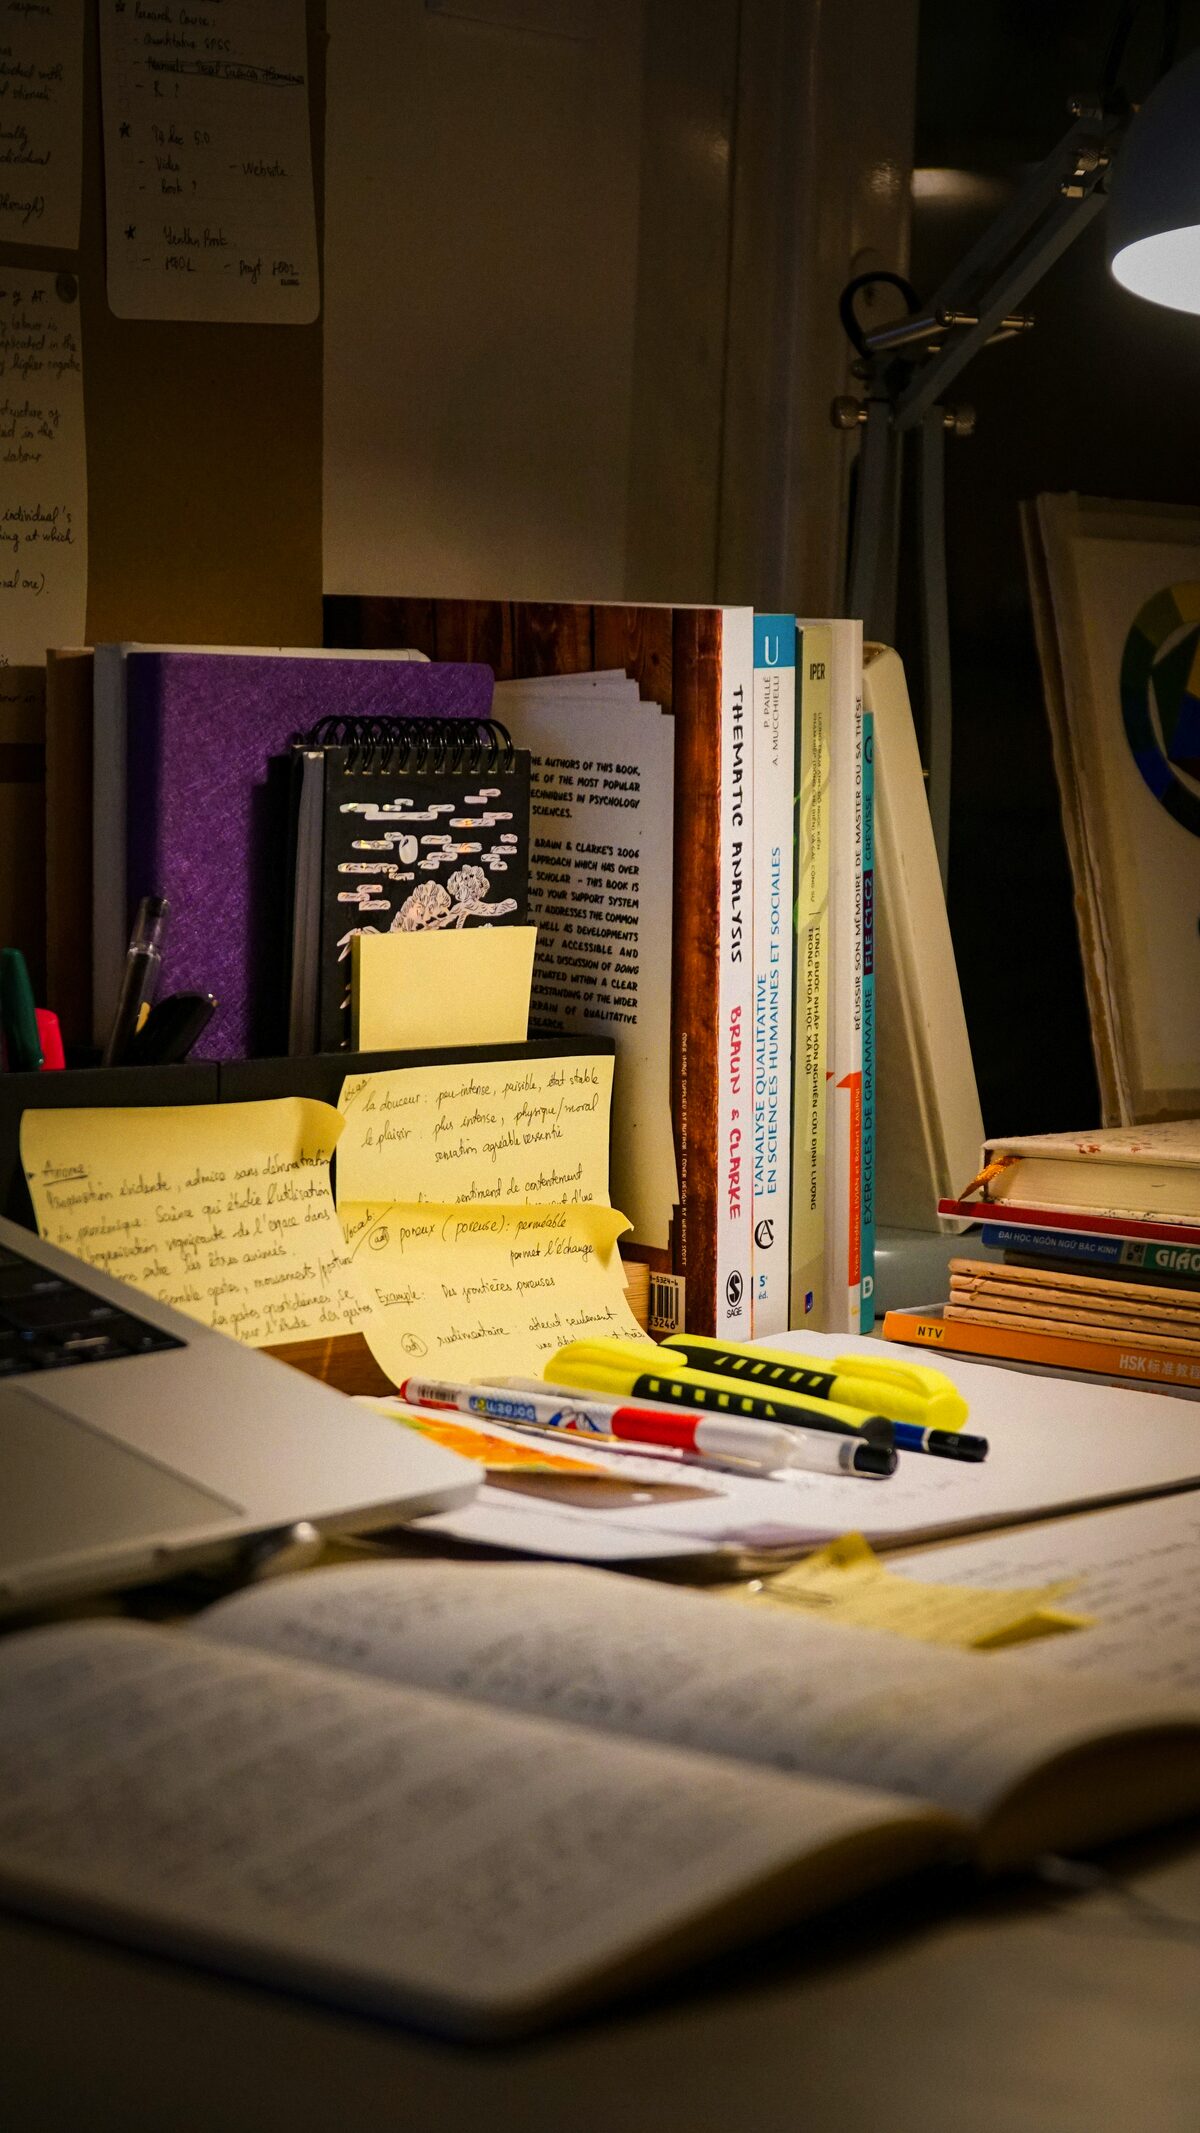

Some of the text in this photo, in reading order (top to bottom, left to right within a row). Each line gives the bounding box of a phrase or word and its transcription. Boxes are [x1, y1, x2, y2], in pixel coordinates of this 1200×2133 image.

[42, 528, 75, 545] which
[764, 635, 779, 666] U
[810, 663, 826, 681] IPER
[763, 675, 771, 717] PAILLÉ
[772, 675, 780, 756] MUCCHIELLI
[855, 745, 862, 762] SA
[545, 757, 641, 777] AUTHORS OF THIS BOOK,
[855, 764, 862, 781] OU
[543, 773, 640, 792] OF THE MOST POPULAR
[530, 789, 640, 809] ECHNIQUES IN PSYCHOLOGY
[532, 805, 573, 818] SCIENCES.
[534, 838, 640, 859] BRAUN & CLARKE'S 2006
[531, 854, 640, 876] APPROACH WHICH HAS OVER
[855, 851, 862, 868] DE
[536, 871, 640, 893] SCHOLAR THIS BOOK IS
[547, 887, 639, 909] YOUR SUPPORT SYSTEM
[535, 904, 639, 926] IT ADDRESSES THE COMMON
[539, 920, 639, 942] WELL AS DEVELOPMENTS
[561, 939, 613, 955] ACCESSIBLE
[619, 947, 639, 959] AND
[728, 683, 744, 1221] THEMATIC ANALYSIS BRAUN & CLARKE
[556, 955, 639, 976] DISCUSSION OF DOING
[532, 969, 638, 992] ITUATED WITHIN A CLEAR
[583, 991, 638, 1009] OF THE WIDER
[854, 976, 862, 1031] RÉUSSIR
[863, 794, 874, 1226] EXERCICES DE GRAMMAIRE FLE C1-C2 GREVISSE
[564, 1005, 638, 1025] OF QUALITATIVE
[767, 847, 781, 1195] EN SCIENCES HUMAINES ET SOCIALES
[569, 1067, 600, 1086] stable
[754, 973, 767, 1197] L'ANALYSE QUALITATIVE
[376, 1120, 411, 1153] plaisir
[506, 1176, 521, 1194] de
[304, 1204, 331, 1223] dans
[399, 1210, 567, 1254] poreux perméable
[1013, 1232, 1031, 1243] HỌC
[1032, 1232, 1057, 1247] NGÔN
[1098, 1244, 1119, 1255] KINH
[510, 1247, 542, 1268] permet
[727, 1306, 744, 1319] SAGE
[917, 1325, 944, 1340] NTV
[1119, 1354, 1148, 1373] HSK
